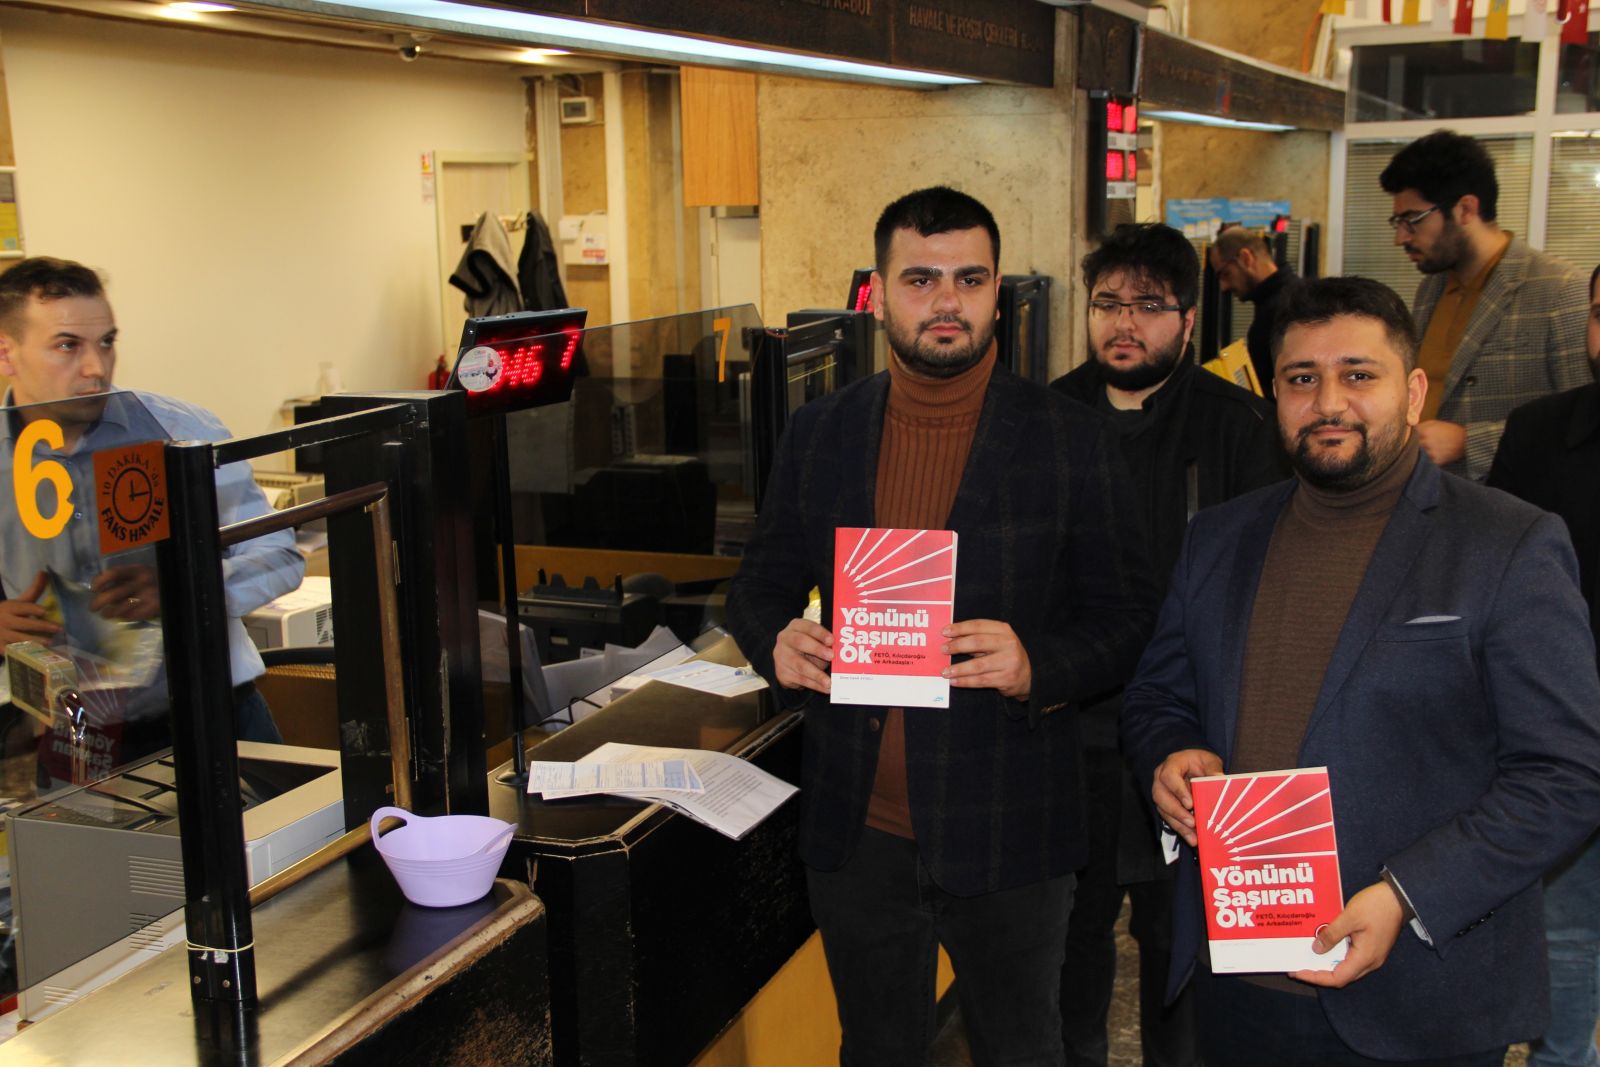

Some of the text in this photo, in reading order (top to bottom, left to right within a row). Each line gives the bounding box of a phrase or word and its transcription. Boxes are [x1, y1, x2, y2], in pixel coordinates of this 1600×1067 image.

[909, 4, 943, 32] HAVALE
[713, 317, 732, 383] 7
[13, 418, 75, 540] 6
[101, 497, 165, 543] FAKS HAVALE
[840, 607, 929, 628] Yönünü
[839, 626, 927, 649] Şaşıran
[839, 645, 873, 664] Ok
[1209, 862, 1315, 887] Yönünü
[1212, 887, 1315, 910] Şaşıran
[1215, 907, 1255, 928] Ok
